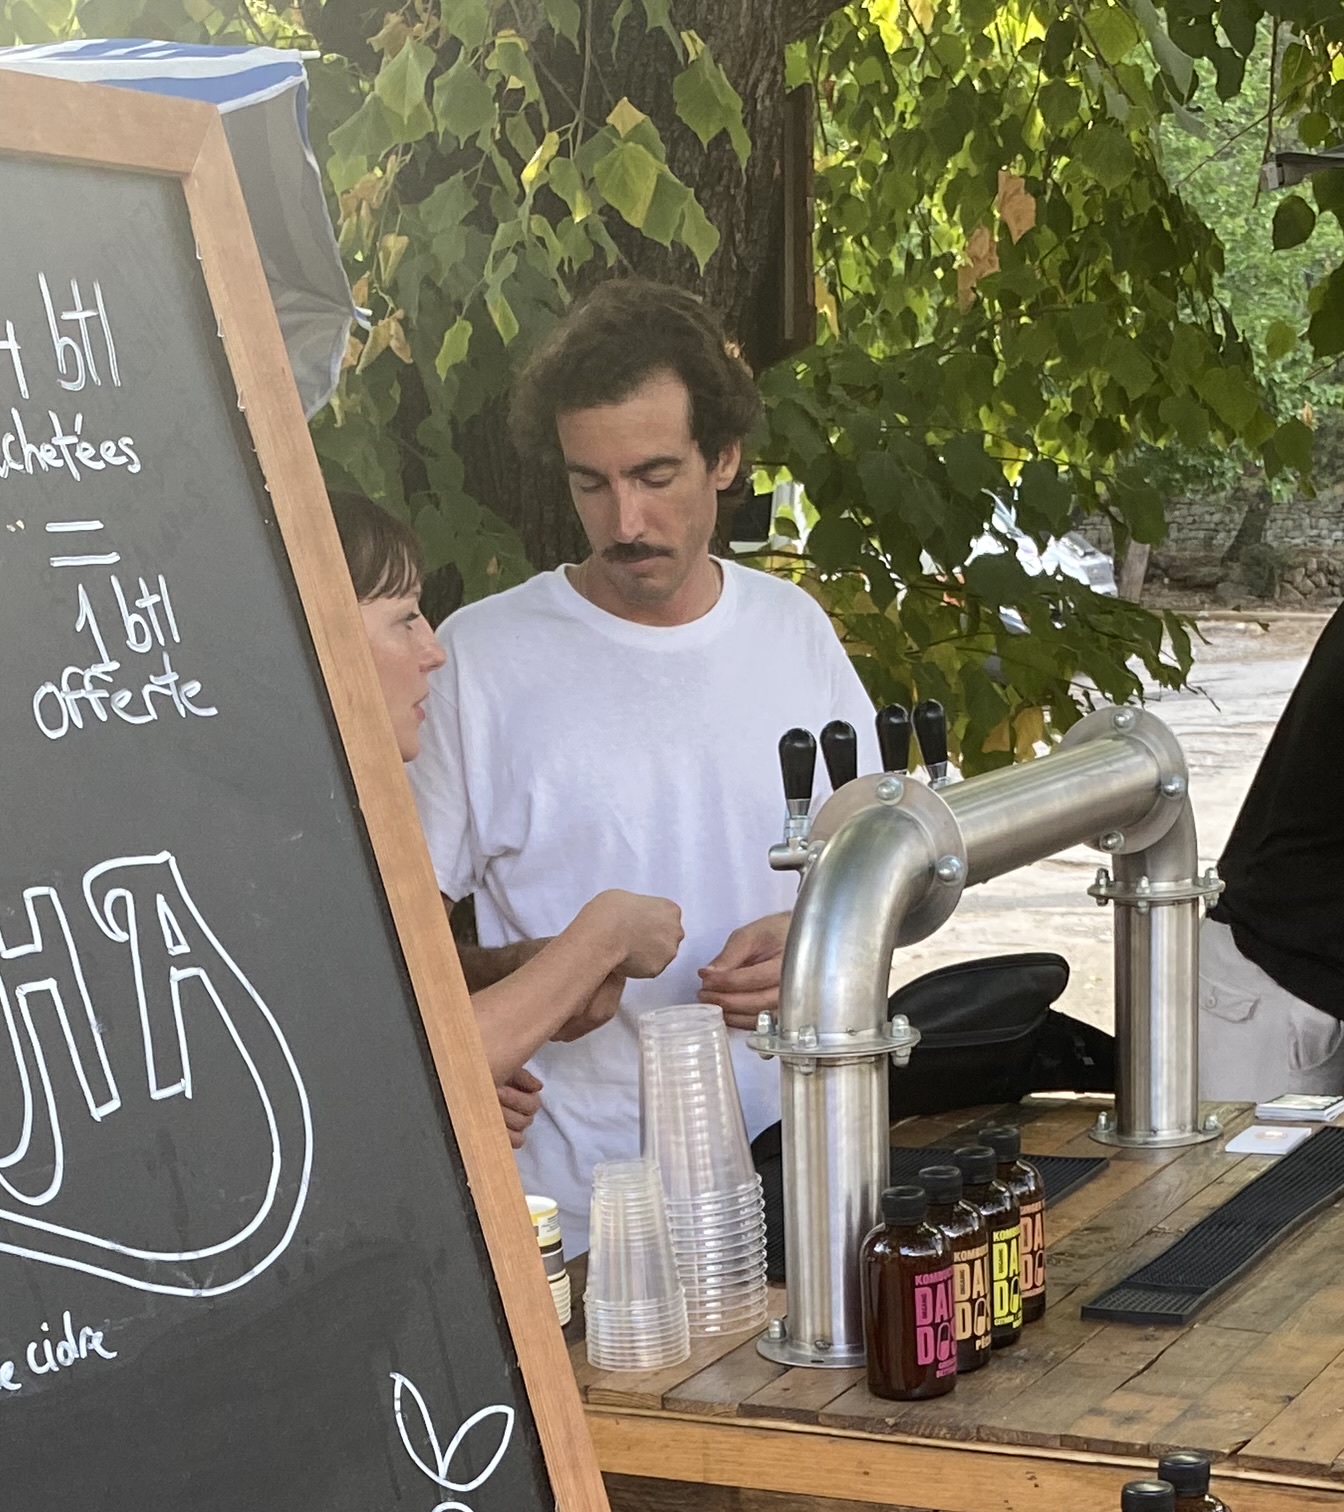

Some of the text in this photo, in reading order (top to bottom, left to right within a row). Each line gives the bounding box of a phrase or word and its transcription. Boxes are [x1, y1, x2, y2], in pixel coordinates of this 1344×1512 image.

[38, 270, 121, 390] btl
[75, 575, 181, 671] 1 btl
[33, 652, 218, 740] offerte
[26, 1310, 117, 1375] cidre
